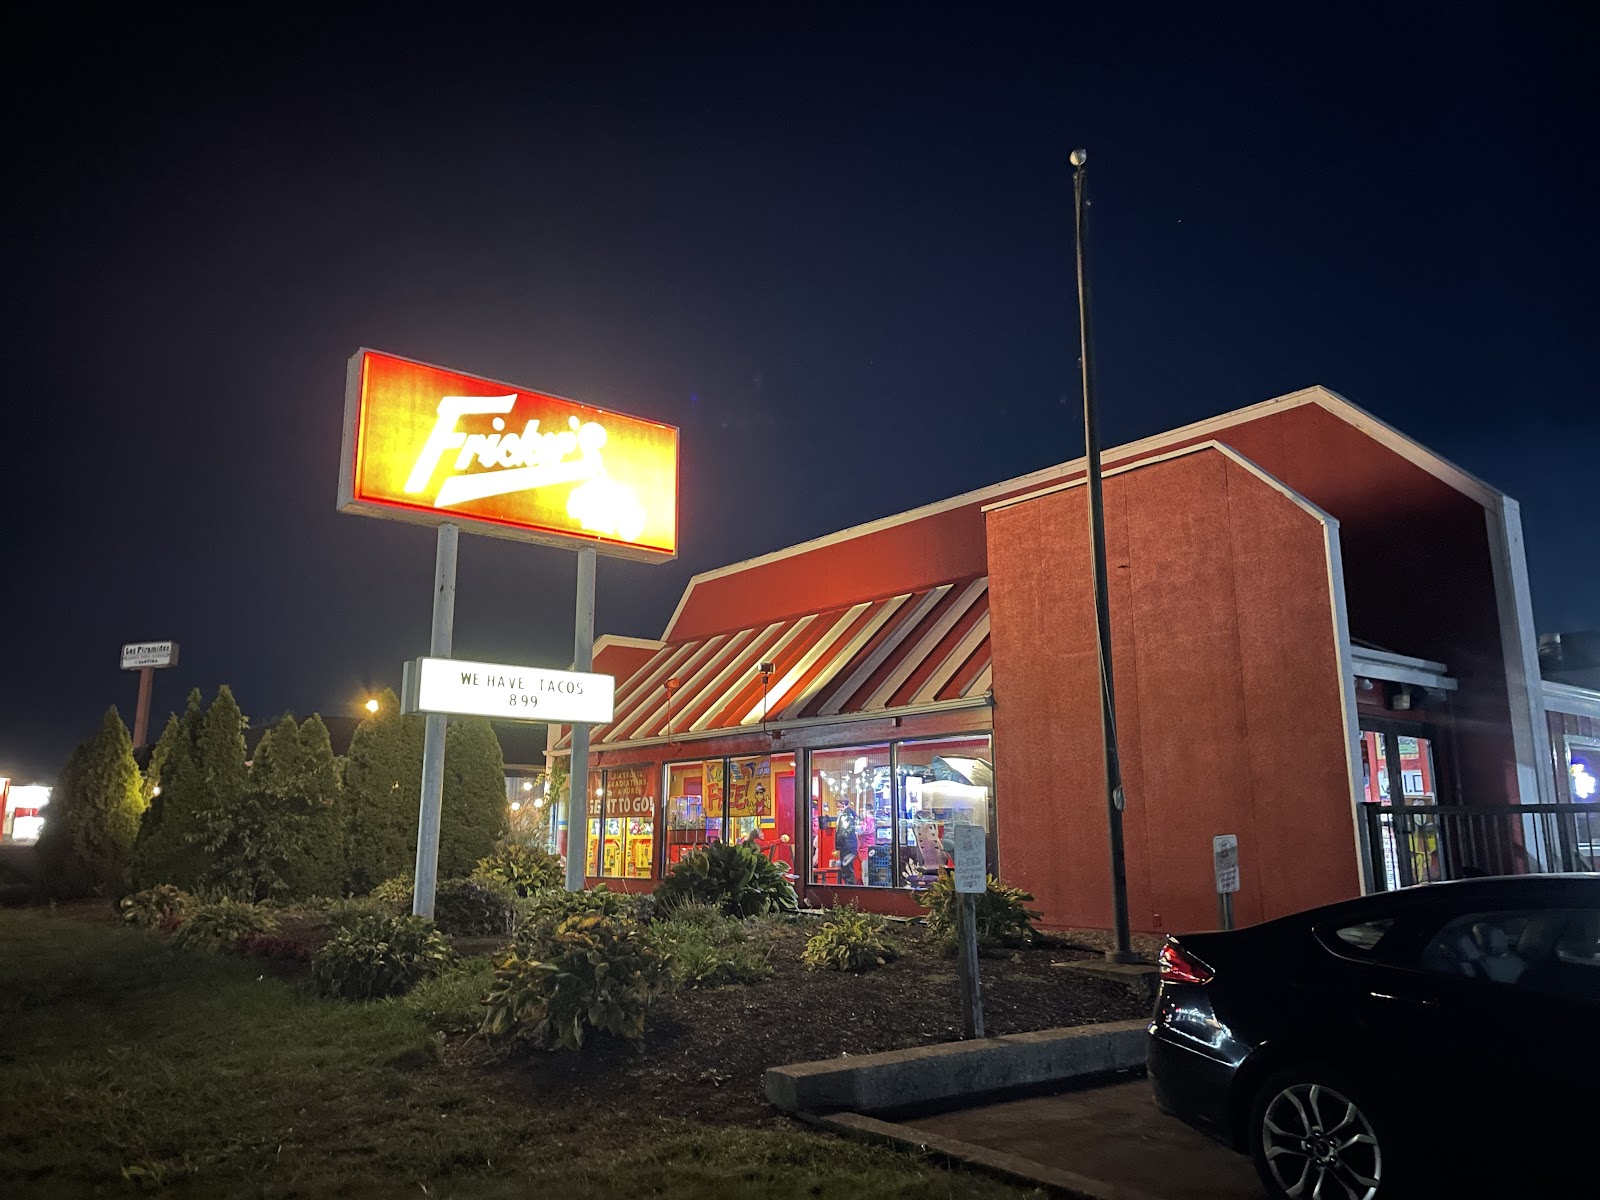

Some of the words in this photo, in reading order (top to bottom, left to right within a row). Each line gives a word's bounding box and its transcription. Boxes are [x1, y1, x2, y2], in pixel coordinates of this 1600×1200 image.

[461, 672, 479, 686] WE
[487, 675, 525, 690] HAVE
[540, 679, 583, 695] TACOS
[509, 694, 538, 708] 899
[619, 797, 631, 812] TO
[633, 796, 653, 812] GO!
